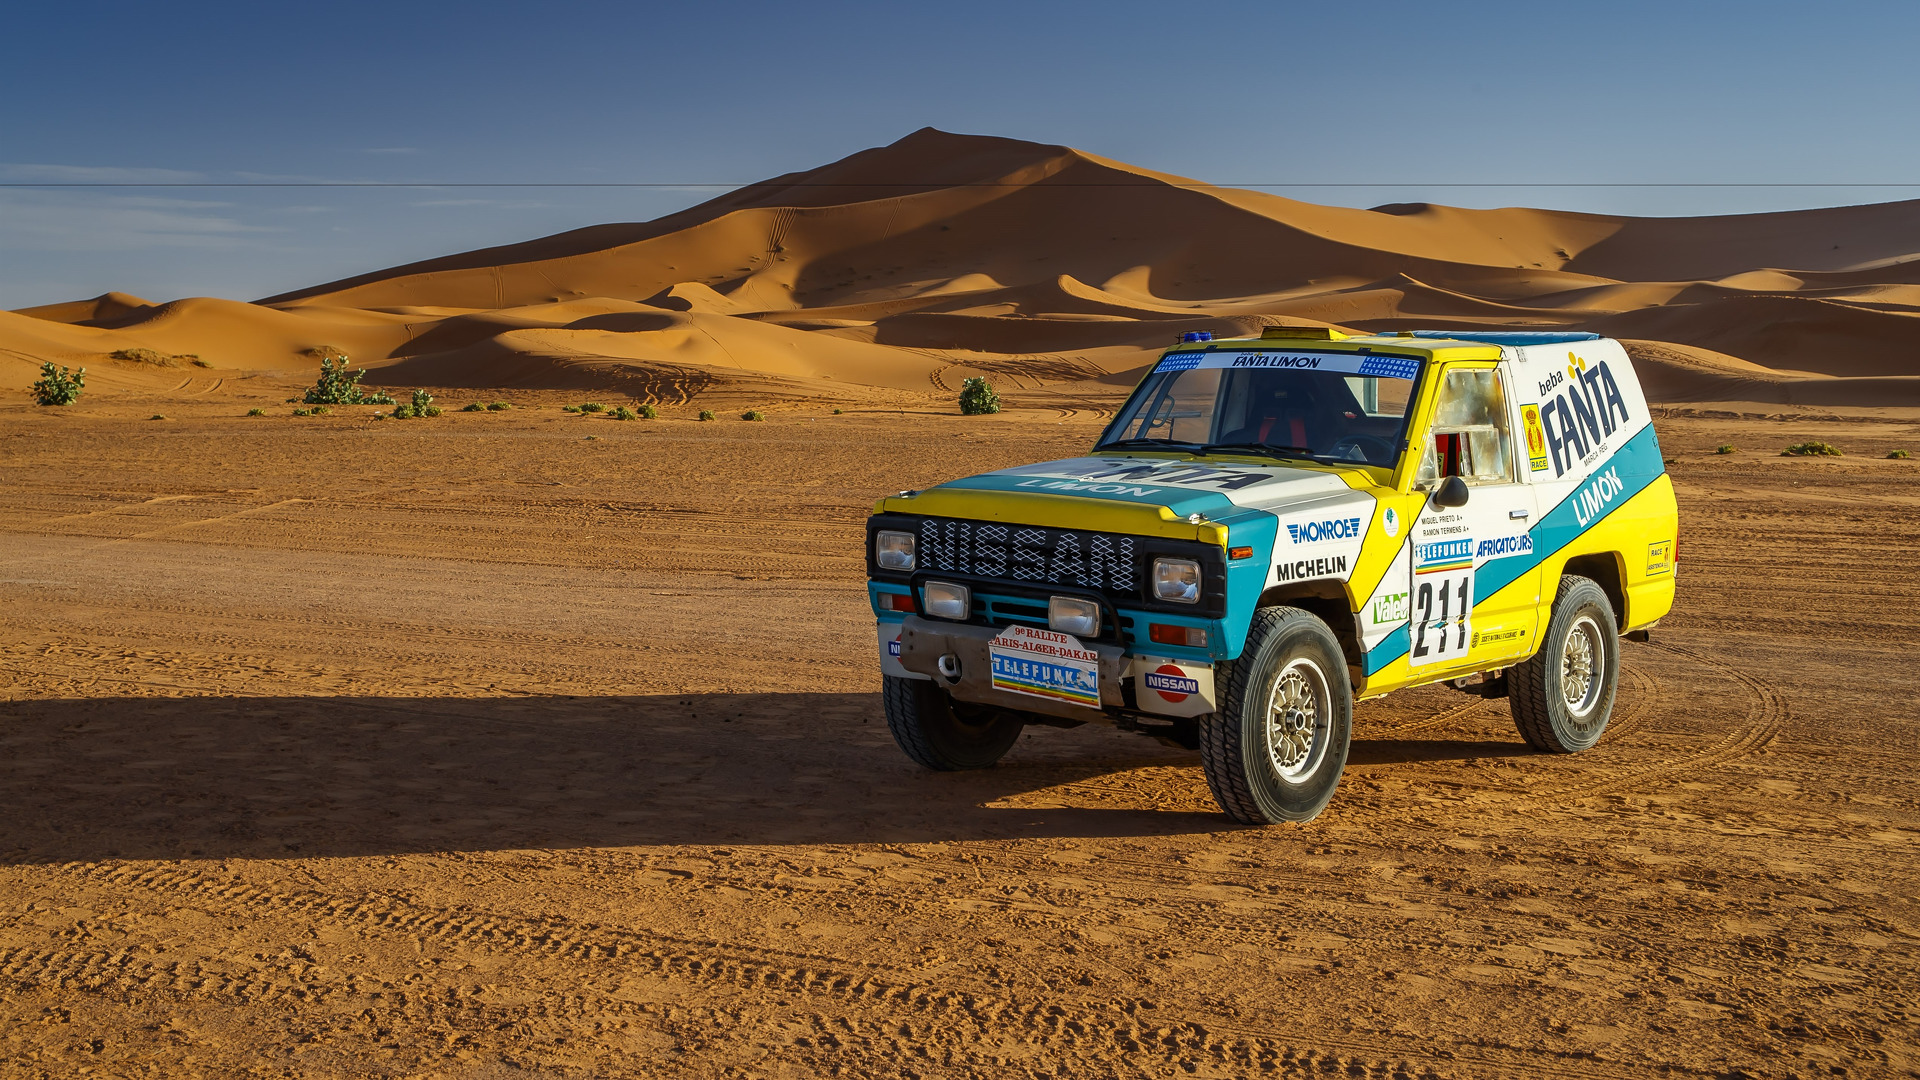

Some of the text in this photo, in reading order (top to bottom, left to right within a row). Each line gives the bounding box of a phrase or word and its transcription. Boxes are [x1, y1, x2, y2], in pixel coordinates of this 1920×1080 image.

[1232, 355, 1322, 368] FANTA LIMON
[1363, 362, 1415, 373] TELEFUNKEN
[1366, 357, 1419, 367] TELEFUNKEN
[1360, 368, 1412, 378] TELEFUNKEN
[1538, 370, 1564, 397] beba
[1541, 360, 1630, 479] FANTA
[1531, 460, 1547, 469] RACE
[1016, 479, 1161, 497] LIMON
[1572, 465, 1624, 528] LIMON
[1421, 516, 1438, 525] MIGUEL
[1439, 514, 1456, 523] PRIETO
[1299, 519, 1353, 544] MONROE
[1422, 528, 1440, 537] RAMON
[1440, 526, 1462, 535] TERMENS
[921, 519, 1134, 591] NISSAN
[1277, 556, 1347, 582] MICHELIN
[1413, 577, 1469, 658] 211
[1026, 628, 1067, 644] RALLYE
[1148, 675, 1196, 692] NISSAN
